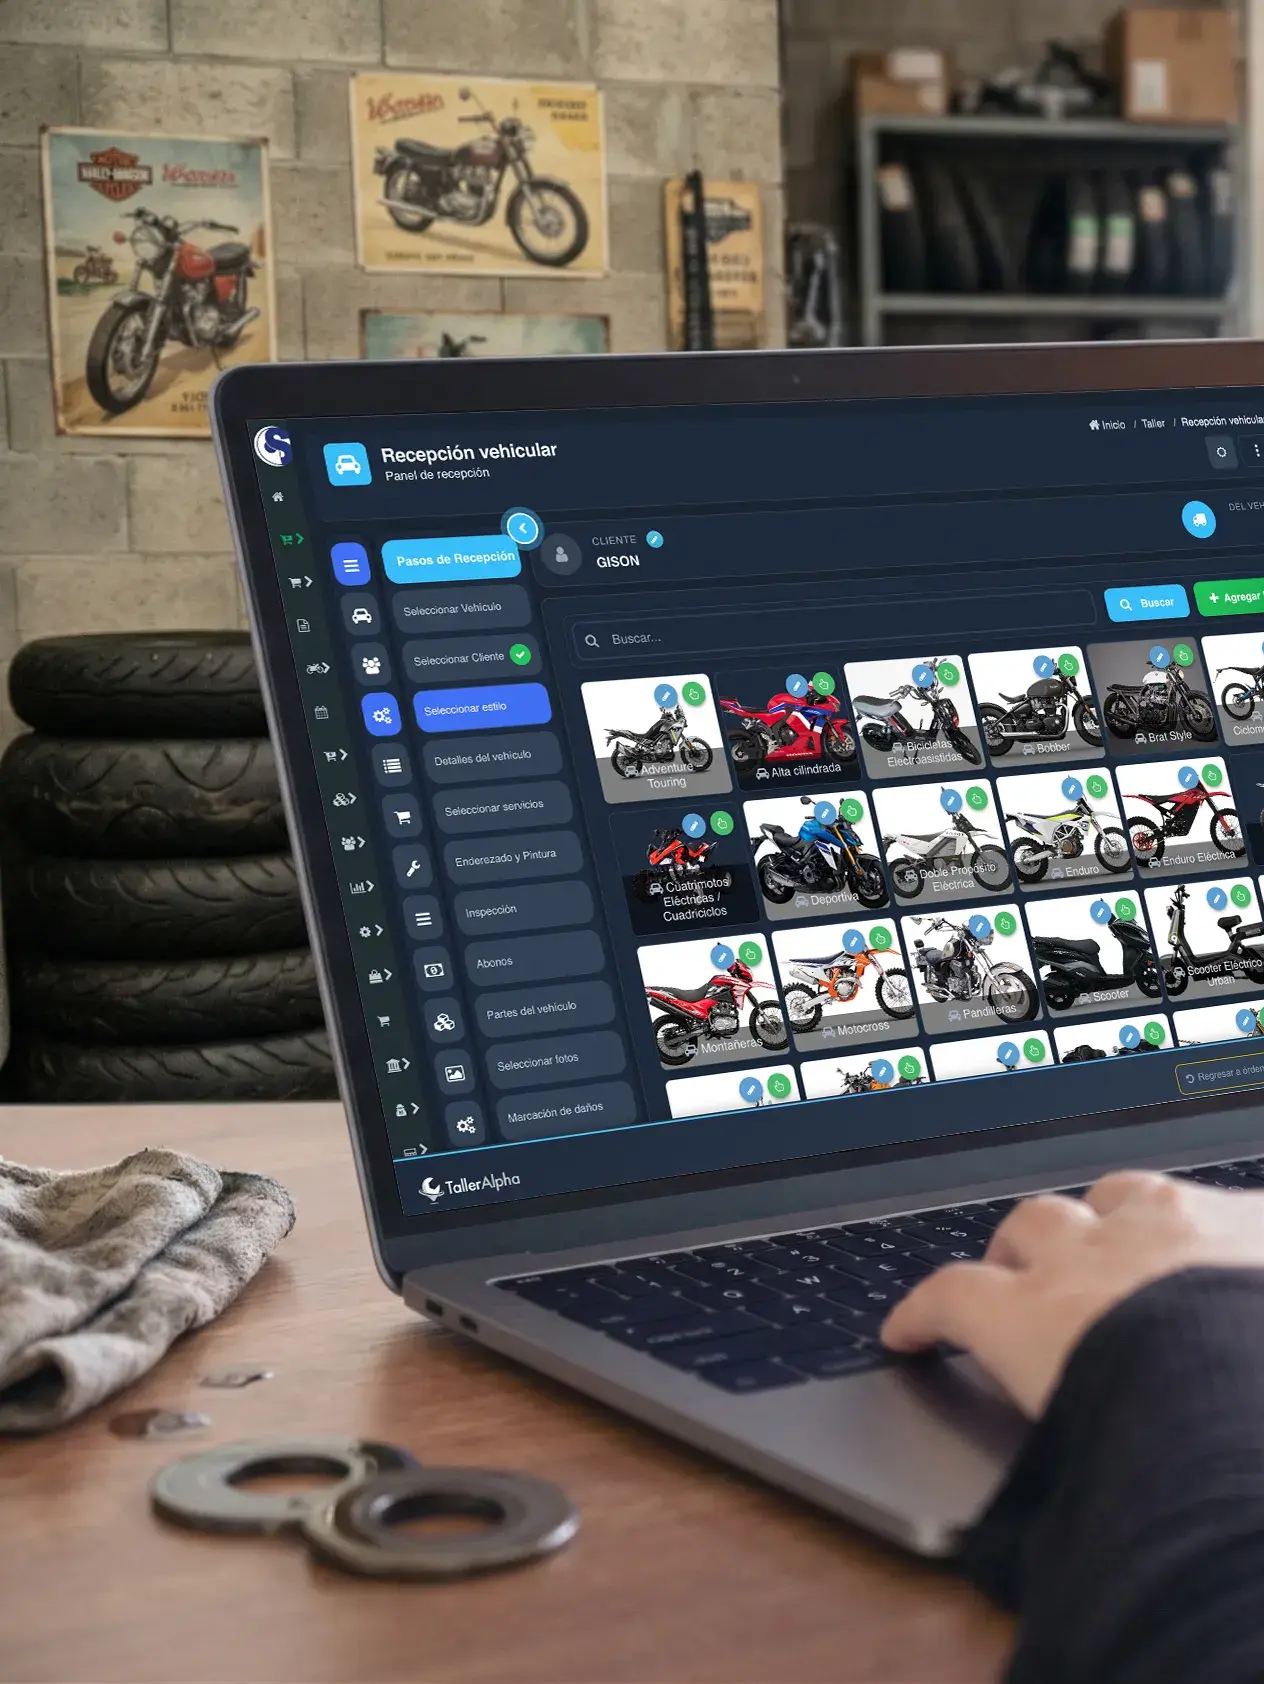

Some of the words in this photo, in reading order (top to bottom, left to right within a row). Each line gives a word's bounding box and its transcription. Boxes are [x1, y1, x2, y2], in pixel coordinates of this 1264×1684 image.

[1102, 420, 1126, 430] Inicio
[1141, 419, 1165, 429] Taller
[1181, 416, 1227, 427] Recepción
[381, 445, 475, 464] Recepción
[479, 442, 558, 460] vehicular
[385, 470, 418, 481] Panel
[420, 469, 434, 480] de
[437, 466, 490, 481] recepción
[1228, 502, 1246, 511] DEL
[592, 535, 637, 546] CLIENTE
[397, 556, 434, 567] Pasos
[437, 555, 451, 564] de
[454, 549, 515, 564] Recepción
[596, 555, 640, 568] GISON
[1140, 597, 1174, 608] Buscar
[1224, 593, 1260, 604] Agregar
[404, 605, 459, 617] Seleccionar
[461, 602, 502, 613] Vehículo
[612, 634, 662, 645] Buscar...
[414, 655, 469, 666] Seleccionar
[471, 652, 505, 662] Cliente
[424, 704, 479, 717] Seleccionar
[481, 702, 507, 712] estilo
[1149, 732, 1169, 743] Brat
[1170, 730, 1192, 742] Style
[906, 740, 953, 752] Bicicletas
[1037, 742, 1070, 754] Bobber
[434, 754, 474, 767] Detalles
[475, 753, 491, 764] del
[492, 750, 532, 761] vehículo
[887, 752, 963, 767] Electroasistidas
[640, 762, 693, 775] Adventure
[771, 766, 791, 777] Alta
[793, 762, 842, 775] cilindrada
[647, 777, 687, 789] Touring
[445, 804, 500, 817] Seleccionar
[503, 800, 544, 811] servicios
[455, 854, 513, 867] Enderezado
[515, 853, 521, 864] y
[523, 849, 557, 860] Pintura
[1163, 855, 1195, 867] Enduro
[1197, 851, 1236, 863] Eléctrica
[920, 867, 948, 879] Doble
[950, 862, 996, 877] Propósito
[1065, 865, 1099, 877] Enduro
[666, 878, 729, 893] Cuatrimotos
[932, 880, 975, 892] Eléctrica
[663, 894, 714, 907] Eléctricas
[810, 892, 860, 905] Deportiva
[465, 904, 517, 918] Inspección
[663, 907, 728, 922] Cuadriciclos
[476, 957, 513, 969] Abonos
[1187, 963, 1222, 976] Scooter
[1224, 958, 1262, 972] Eléctrico
[1207, 975, 1235, 987] Urban
[1093, 989, 1130, 1002] Scooter
[486, 1008, 518, 1020] Partes
[520, 1006, 535, 1016] del
[537, 1001, 577, 1013] vehículo
[962, 1003, 1017, 1019] Pandilleras
[837, 1021, 890, 1035] Motocross
[701, 1036, 763, 1053] Montañeras
[497, 1058, 553, 1072] Seleccionar
[555, 1053, 579, 1064] fotos
[1198, 1070, 1234, 1083] Regresar
[508, 1108, 557, 1123] Marcación
[559, 1106, 572, 1116] de
[574, 1102, 604, 1114] daños
[445, 1172, 520, 1195] TallerAlpha
